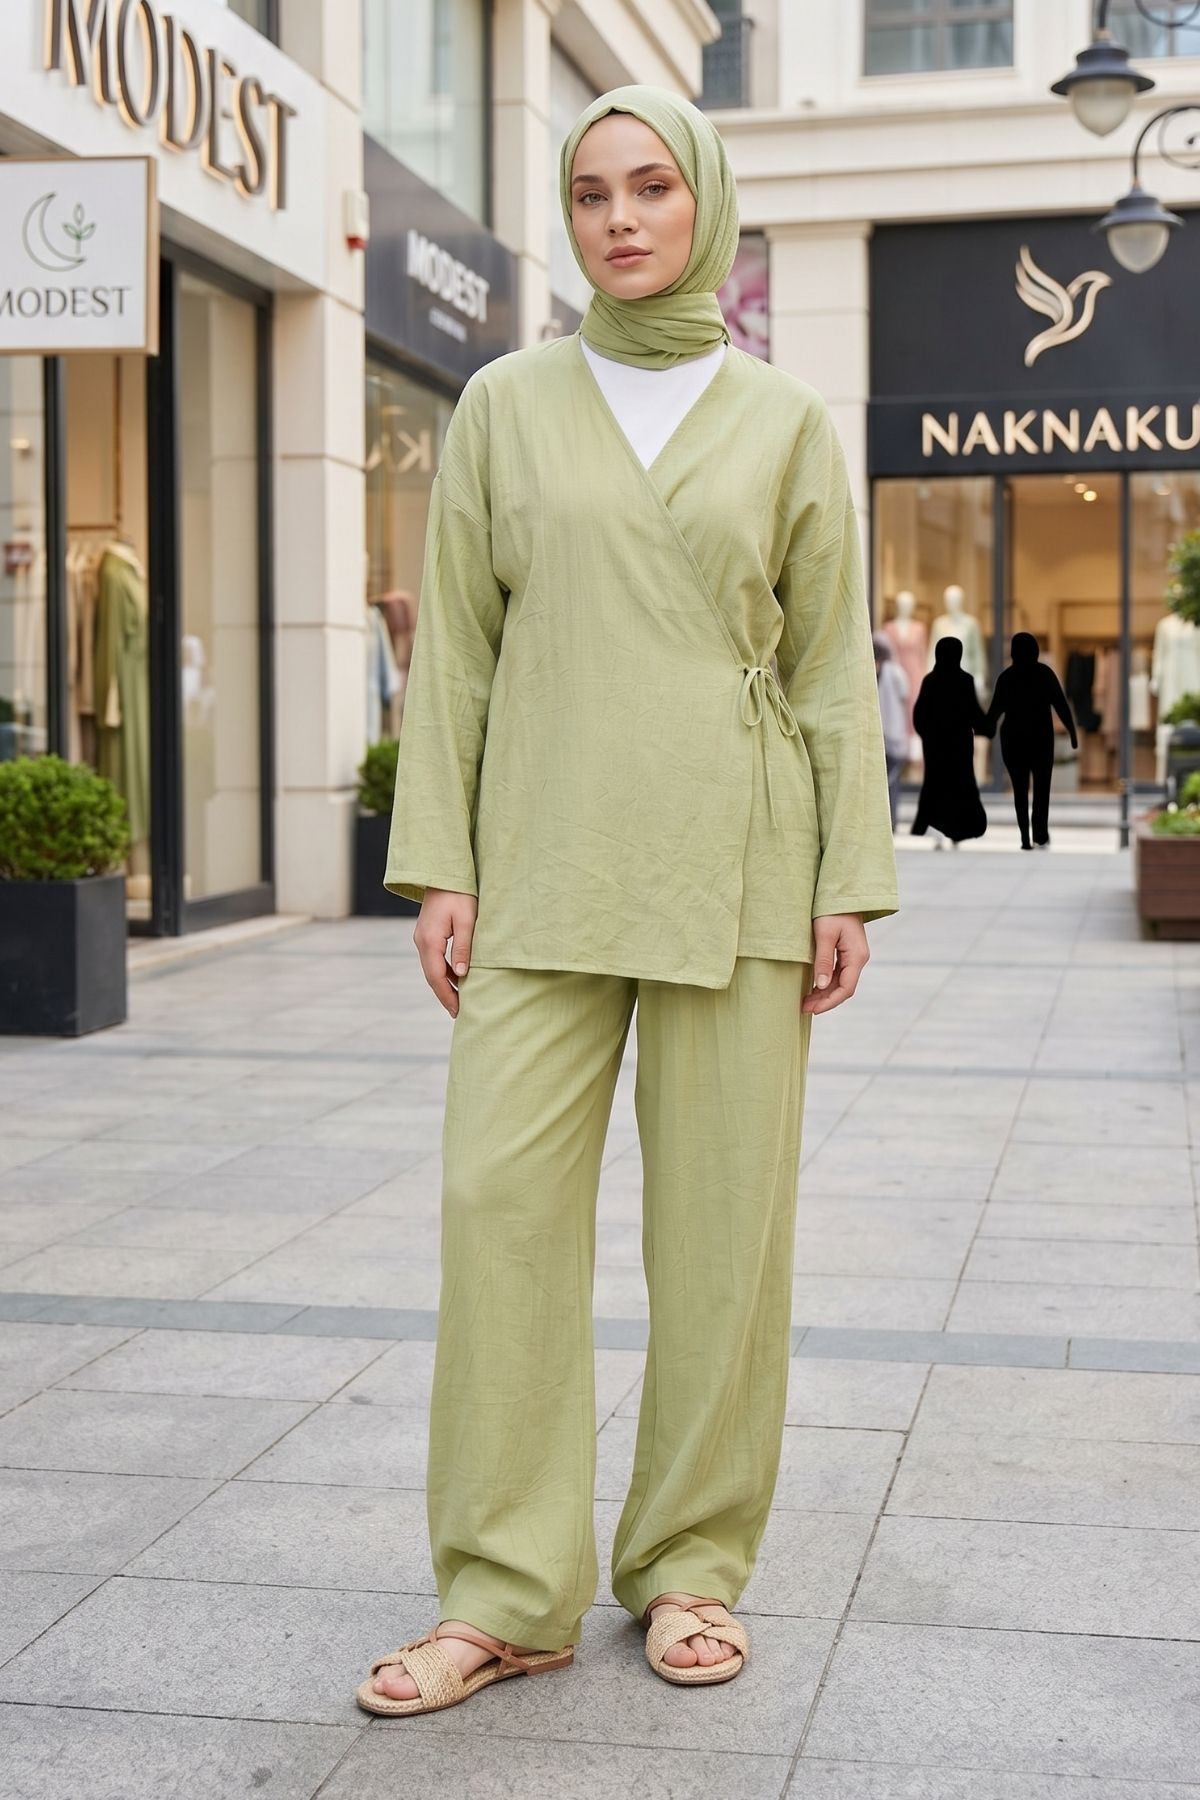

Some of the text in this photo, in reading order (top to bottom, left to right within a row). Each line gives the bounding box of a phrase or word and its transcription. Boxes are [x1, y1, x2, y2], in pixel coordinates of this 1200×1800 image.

[43, 0, 297, 210] MODEST
[407, 229, 490, 323] MODEST
[921, 404, 1200, 457] NAKNAKU
